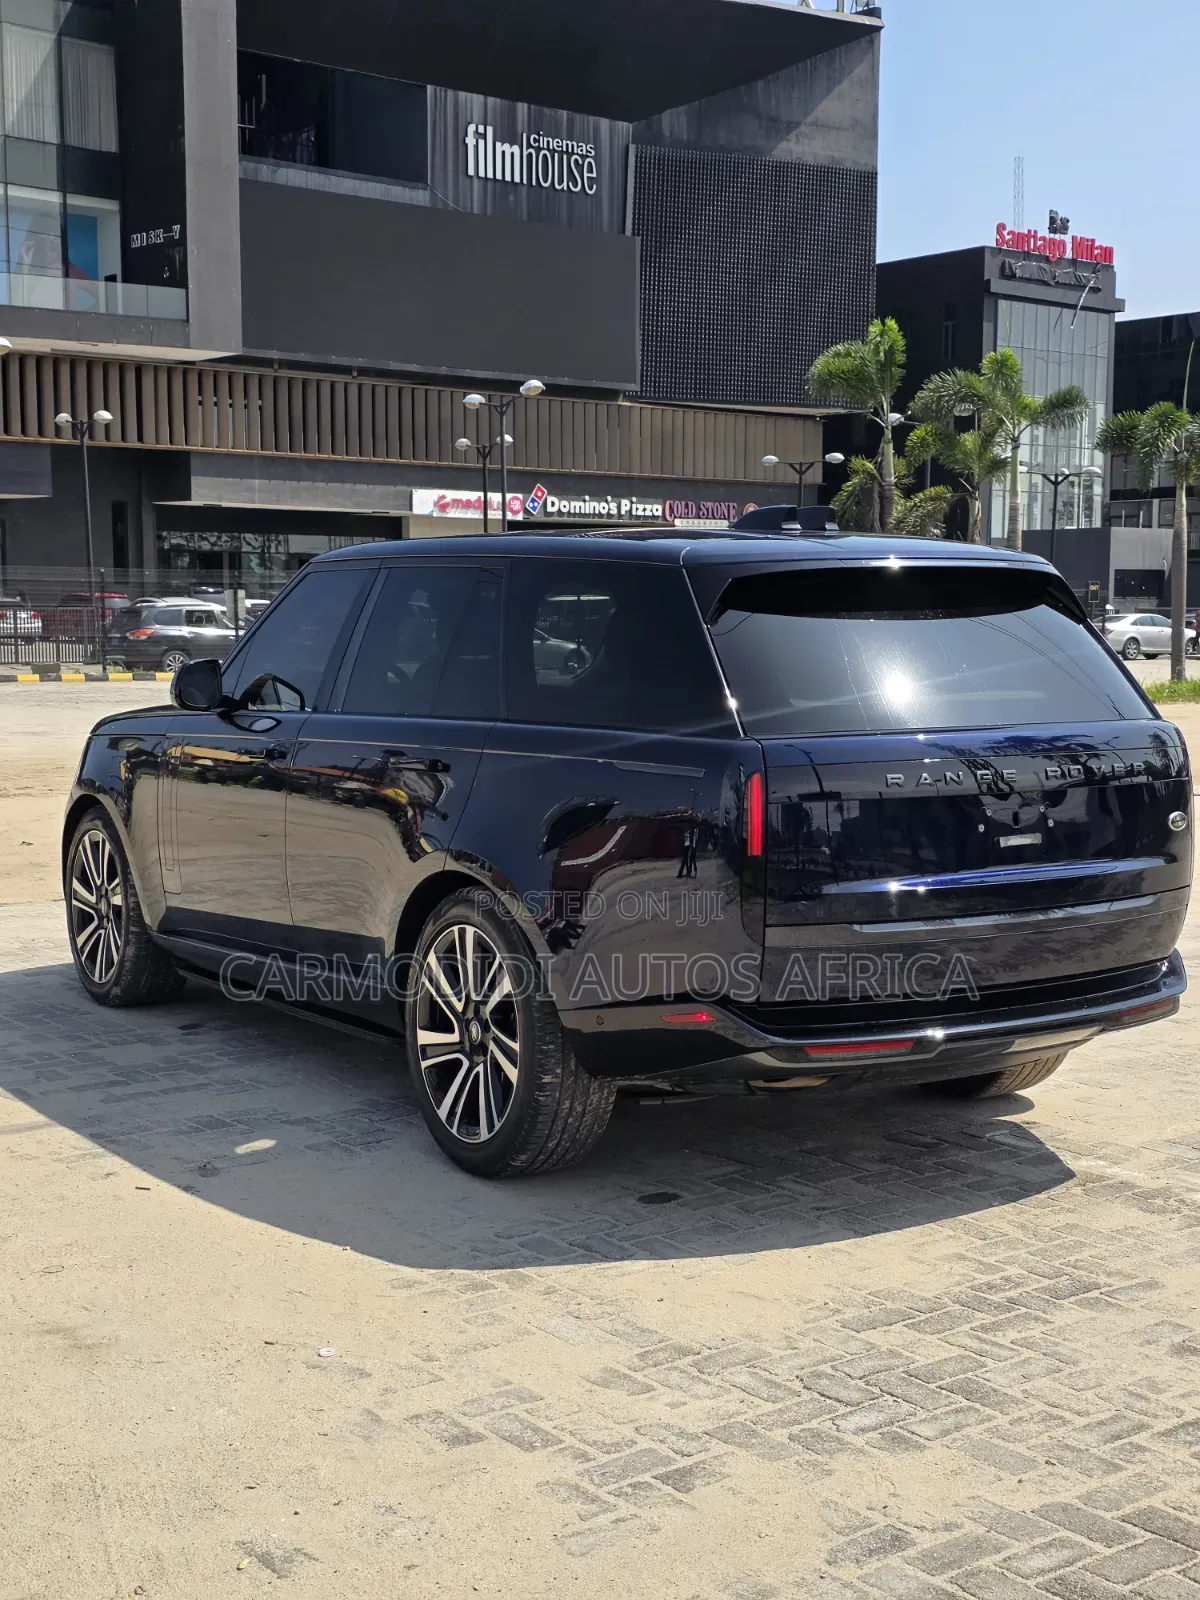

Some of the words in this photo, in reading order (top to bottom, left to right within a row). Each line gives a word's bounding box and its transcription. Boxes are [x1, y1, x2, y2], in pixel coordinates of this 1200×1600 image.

[530, 131, 595, 156] cinemas
[996, 222, 1067, 262] Santiago
[1072, 235, 1114, 264] Milan
[546, 495, 618, 515] Domino's
[620, 496, 663, 516] Pizza
[664, 500, 697, 521] COLD
[699, 502, 738, 522] STONE
[885, 769, 1018, 788] RANGE
[1044, 762, 1147, 781] ROVER
